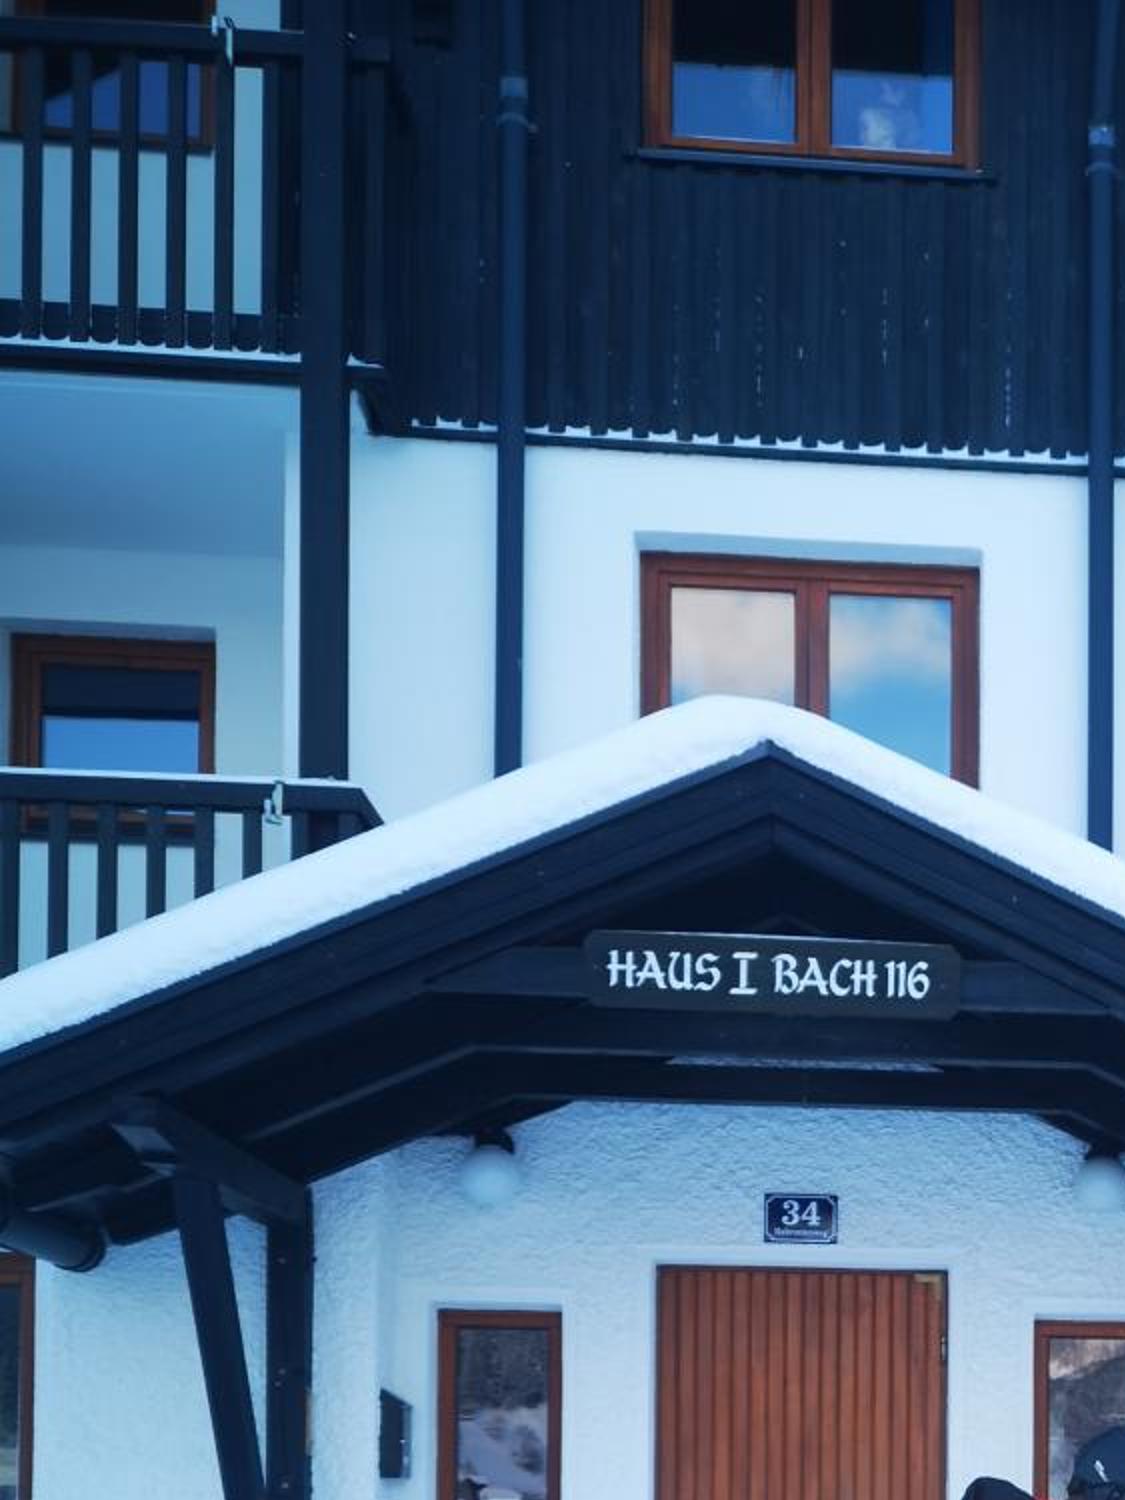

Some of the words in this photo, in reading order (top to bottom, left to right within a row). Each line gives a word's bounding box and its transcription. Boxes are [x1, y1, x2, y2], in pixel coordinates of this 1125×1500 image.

[606, 949, 721, 991] HAUS
[728, 951, 759, 995] I
[771, 953, 877, 998] BACH
[885, 960, 931, 1000] 116
[781, 1199, 821, 1227] 34
